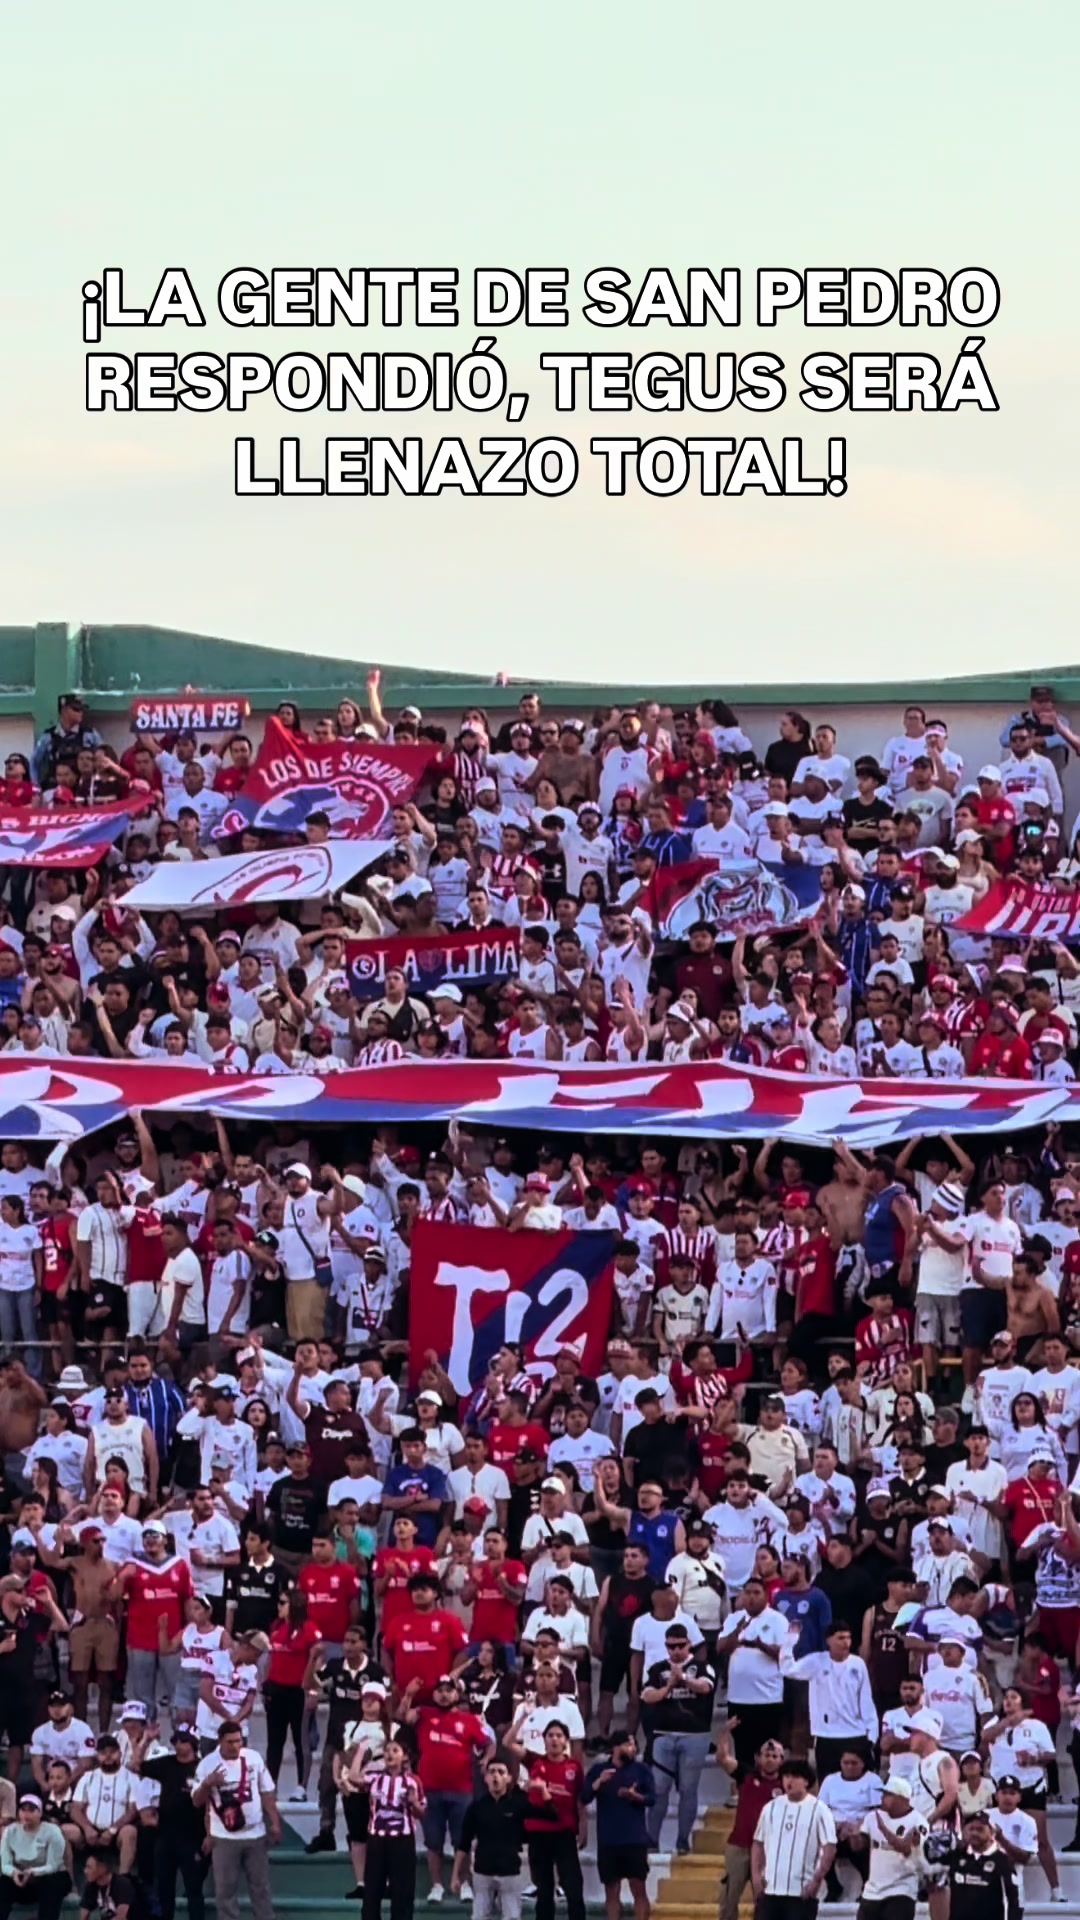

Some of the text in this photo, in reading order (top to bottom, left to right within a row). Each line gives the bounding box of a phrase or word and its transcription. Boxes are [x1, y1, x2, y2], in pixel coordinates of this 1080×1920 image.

[136, 702, 239, 729] SANTA FE
[258, 751, 414, 797] LOS DE SIEMPRE
[440, 940, 519, 980] LIMA
